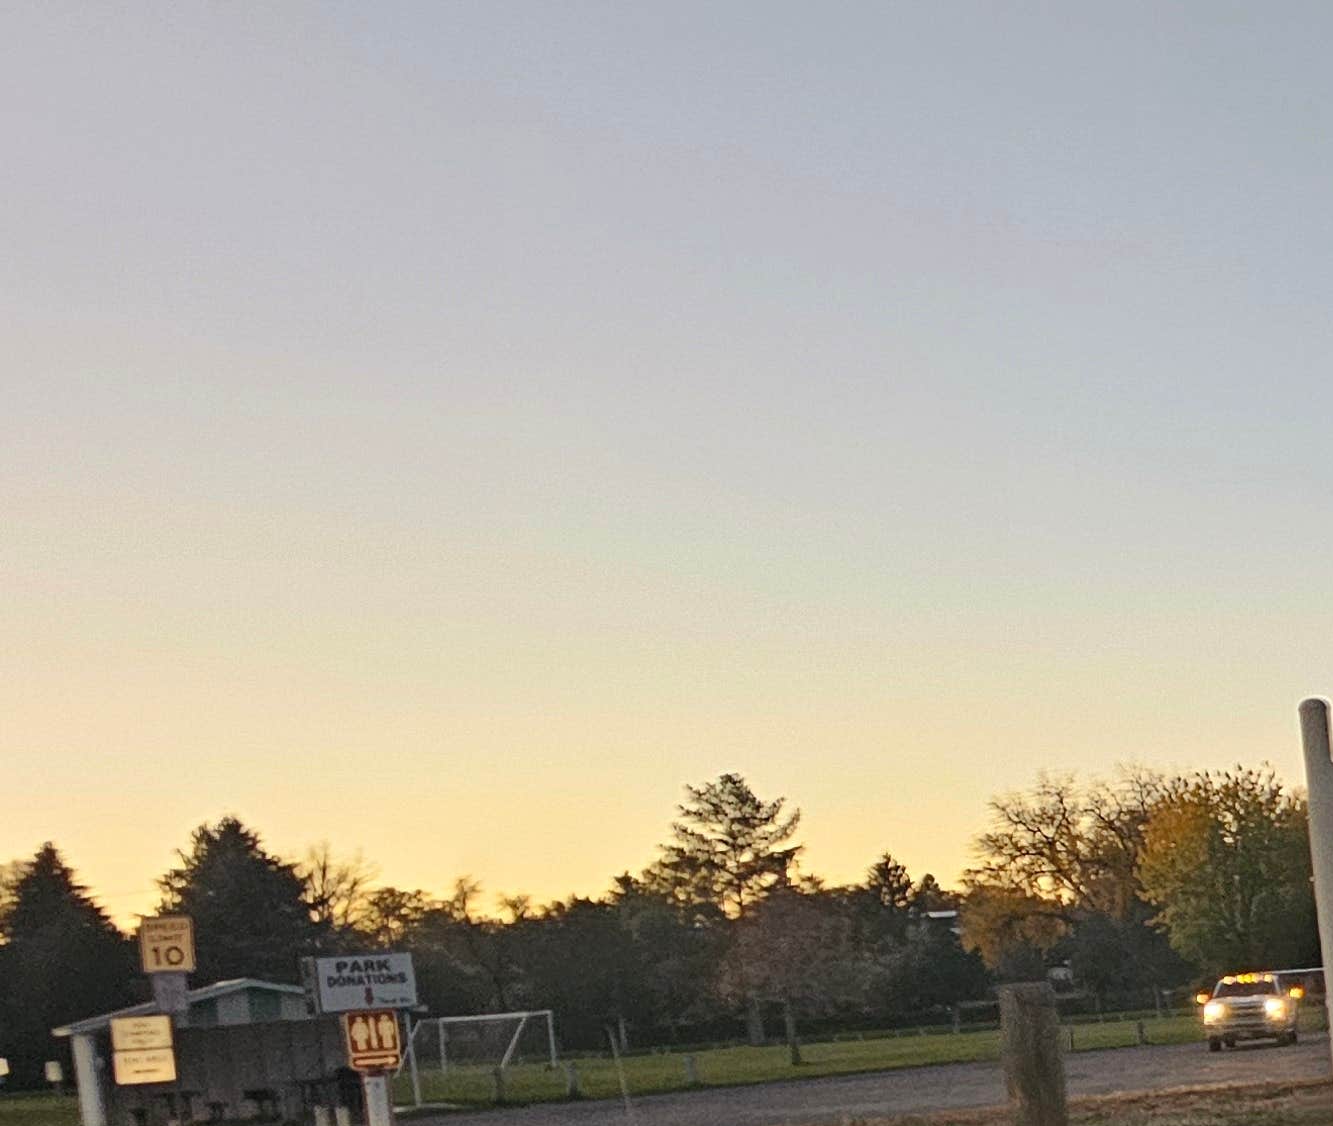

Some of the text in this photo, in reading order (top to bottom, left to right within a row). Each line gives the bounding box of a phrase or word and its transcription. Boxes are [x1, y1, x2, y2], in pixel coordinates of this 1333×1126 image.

[152, 946, 185, 966] 10
[335, 958, 391, 974] PARK
[326, 971, 409, 988] DONATIONS
